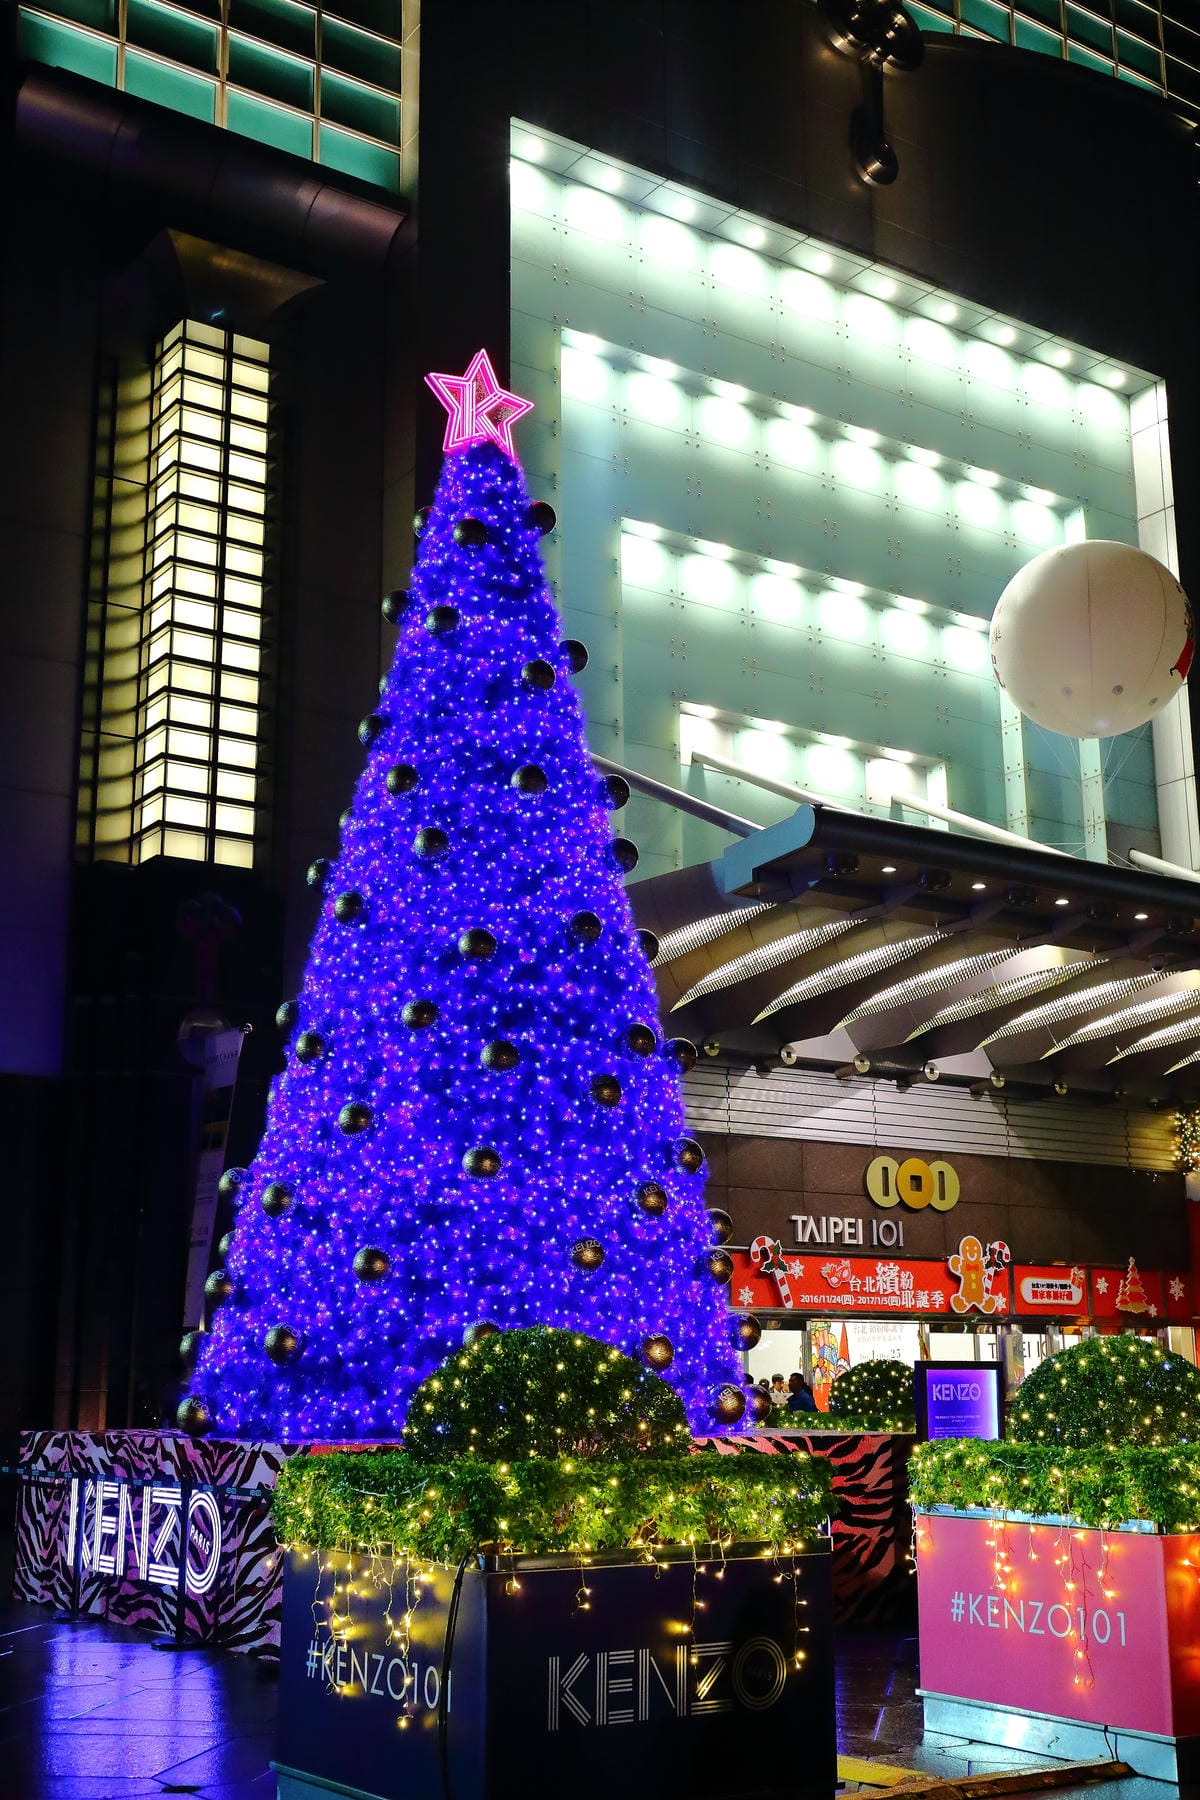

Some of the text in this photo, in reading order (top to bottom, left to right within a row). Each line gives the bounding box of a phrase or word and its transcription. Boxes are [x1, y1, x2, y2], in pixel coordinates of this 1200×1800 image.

[790, 1214, 863, 1245] TAIPEI
[849, 1262, 914, 1295] 台北繽紛
[901, 1290, 945, 1309] 耶誕季
[932, 1382, 982, 1401] KENZO
[66, 1476, 223, 1595] KENZO
[189, 1524, 211, 1555] PARIS
[950, 1591, 1127, 1647] #KENZO101
[305, 1639, 453, 1714] #KENZO101
[546, 1636, 787, 1732] KENZO
